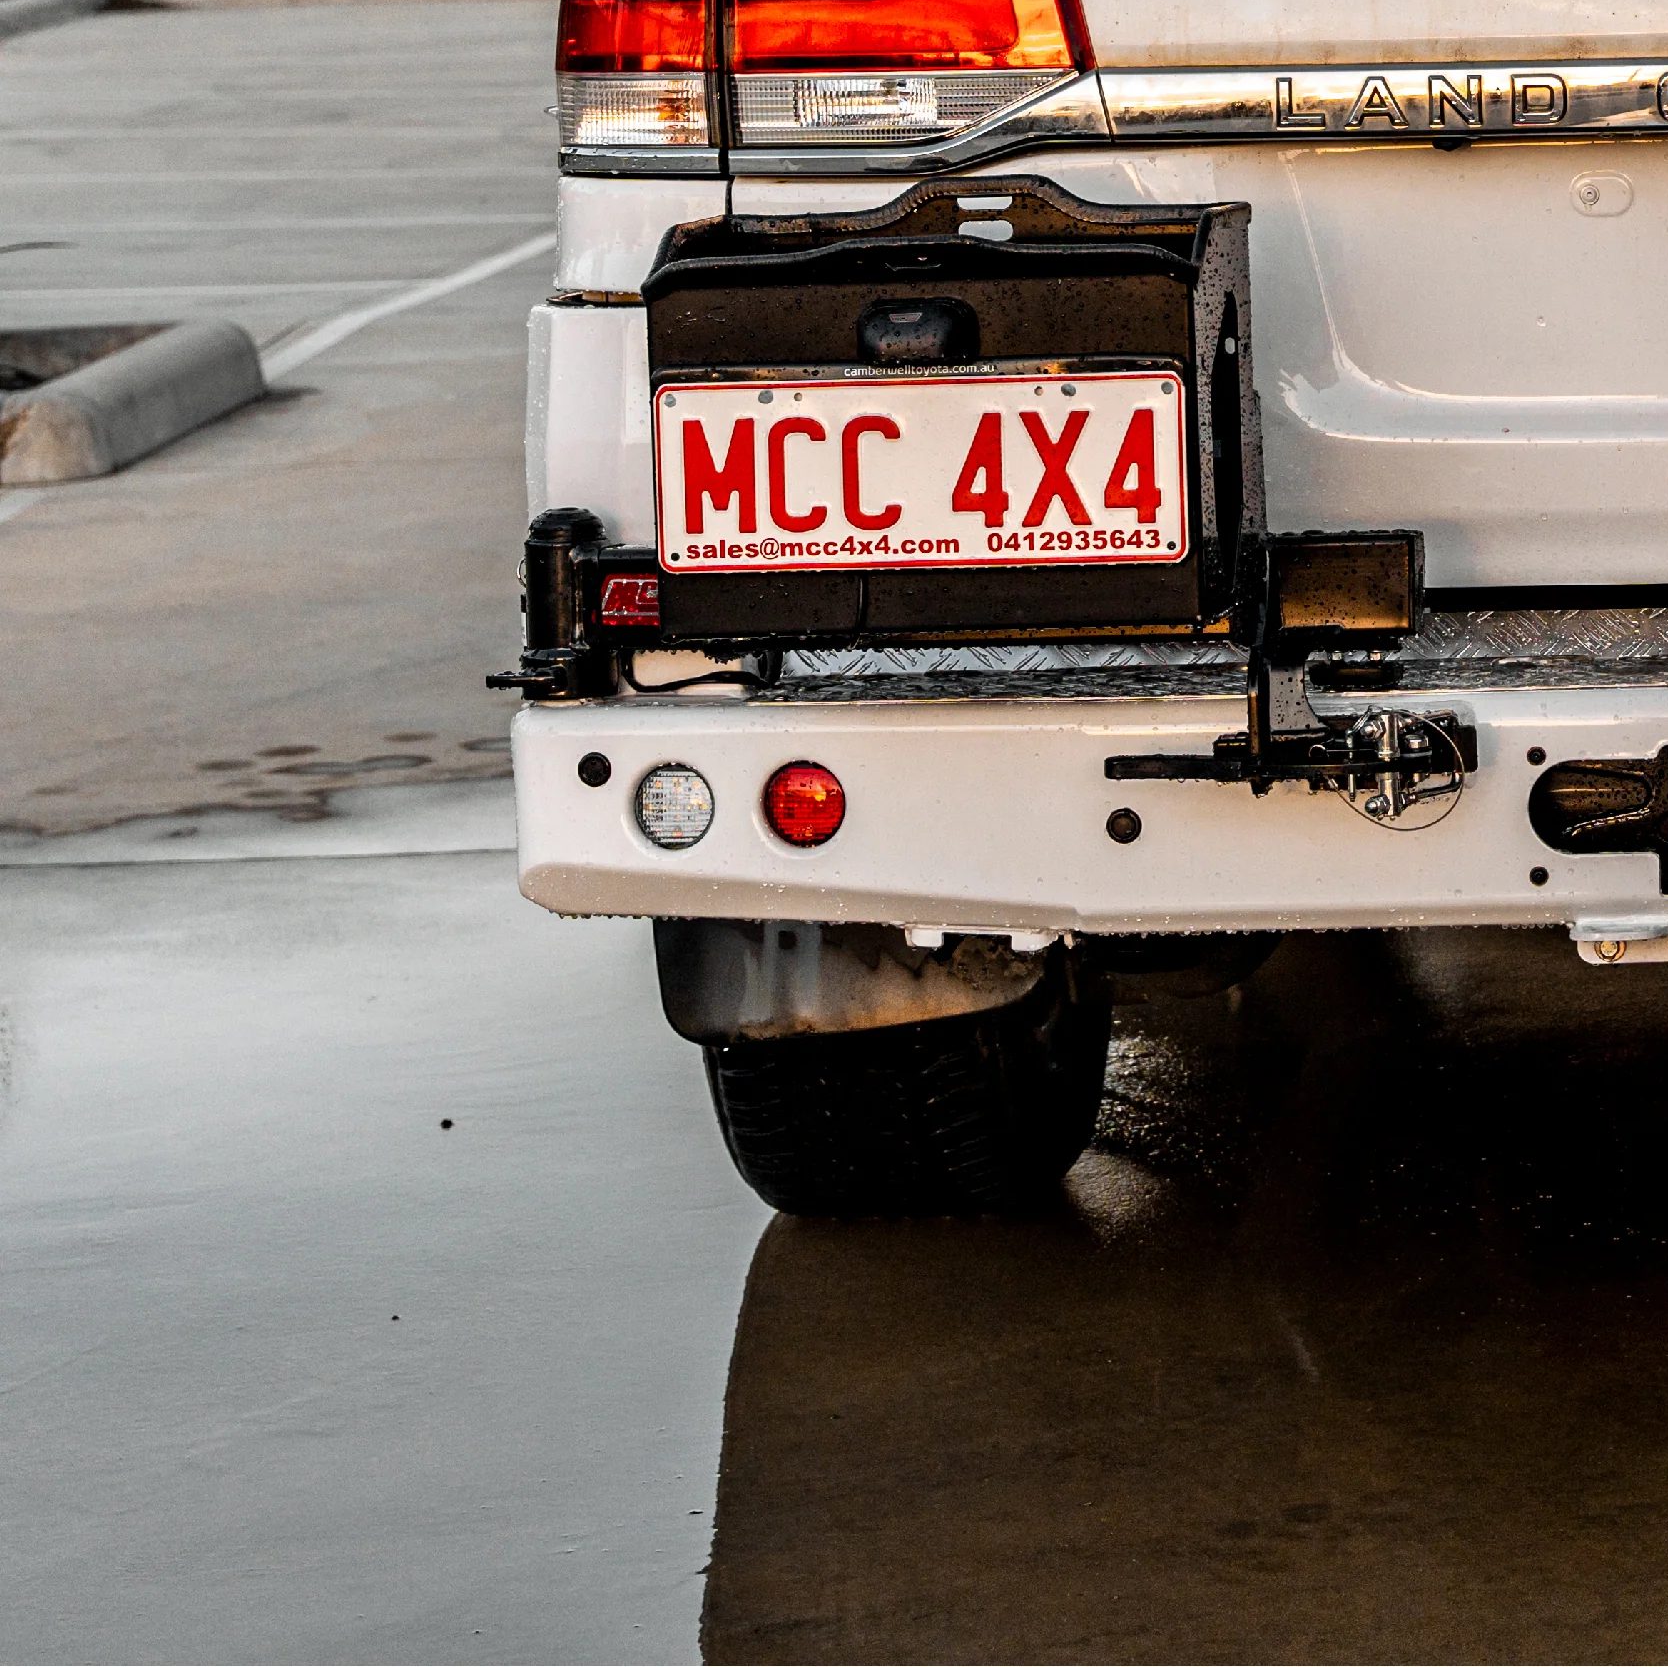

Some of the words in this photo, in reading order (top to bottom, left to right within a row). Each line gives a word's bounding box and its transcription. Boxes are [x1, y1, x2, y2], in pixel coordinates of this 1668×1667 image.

[1274, 73, 1569, 130] LAND
[843, 363, 996, 378] camberwelltoyota.com.au
[682, 415, 902, 535] MCC
[951, 408, 1163, 529] 4X4
[686, 533, 960, 560] sales@mcc4x4.com
[986, 528, 1162, 553] 0412935643
[601, 578, 659, 616] MC
